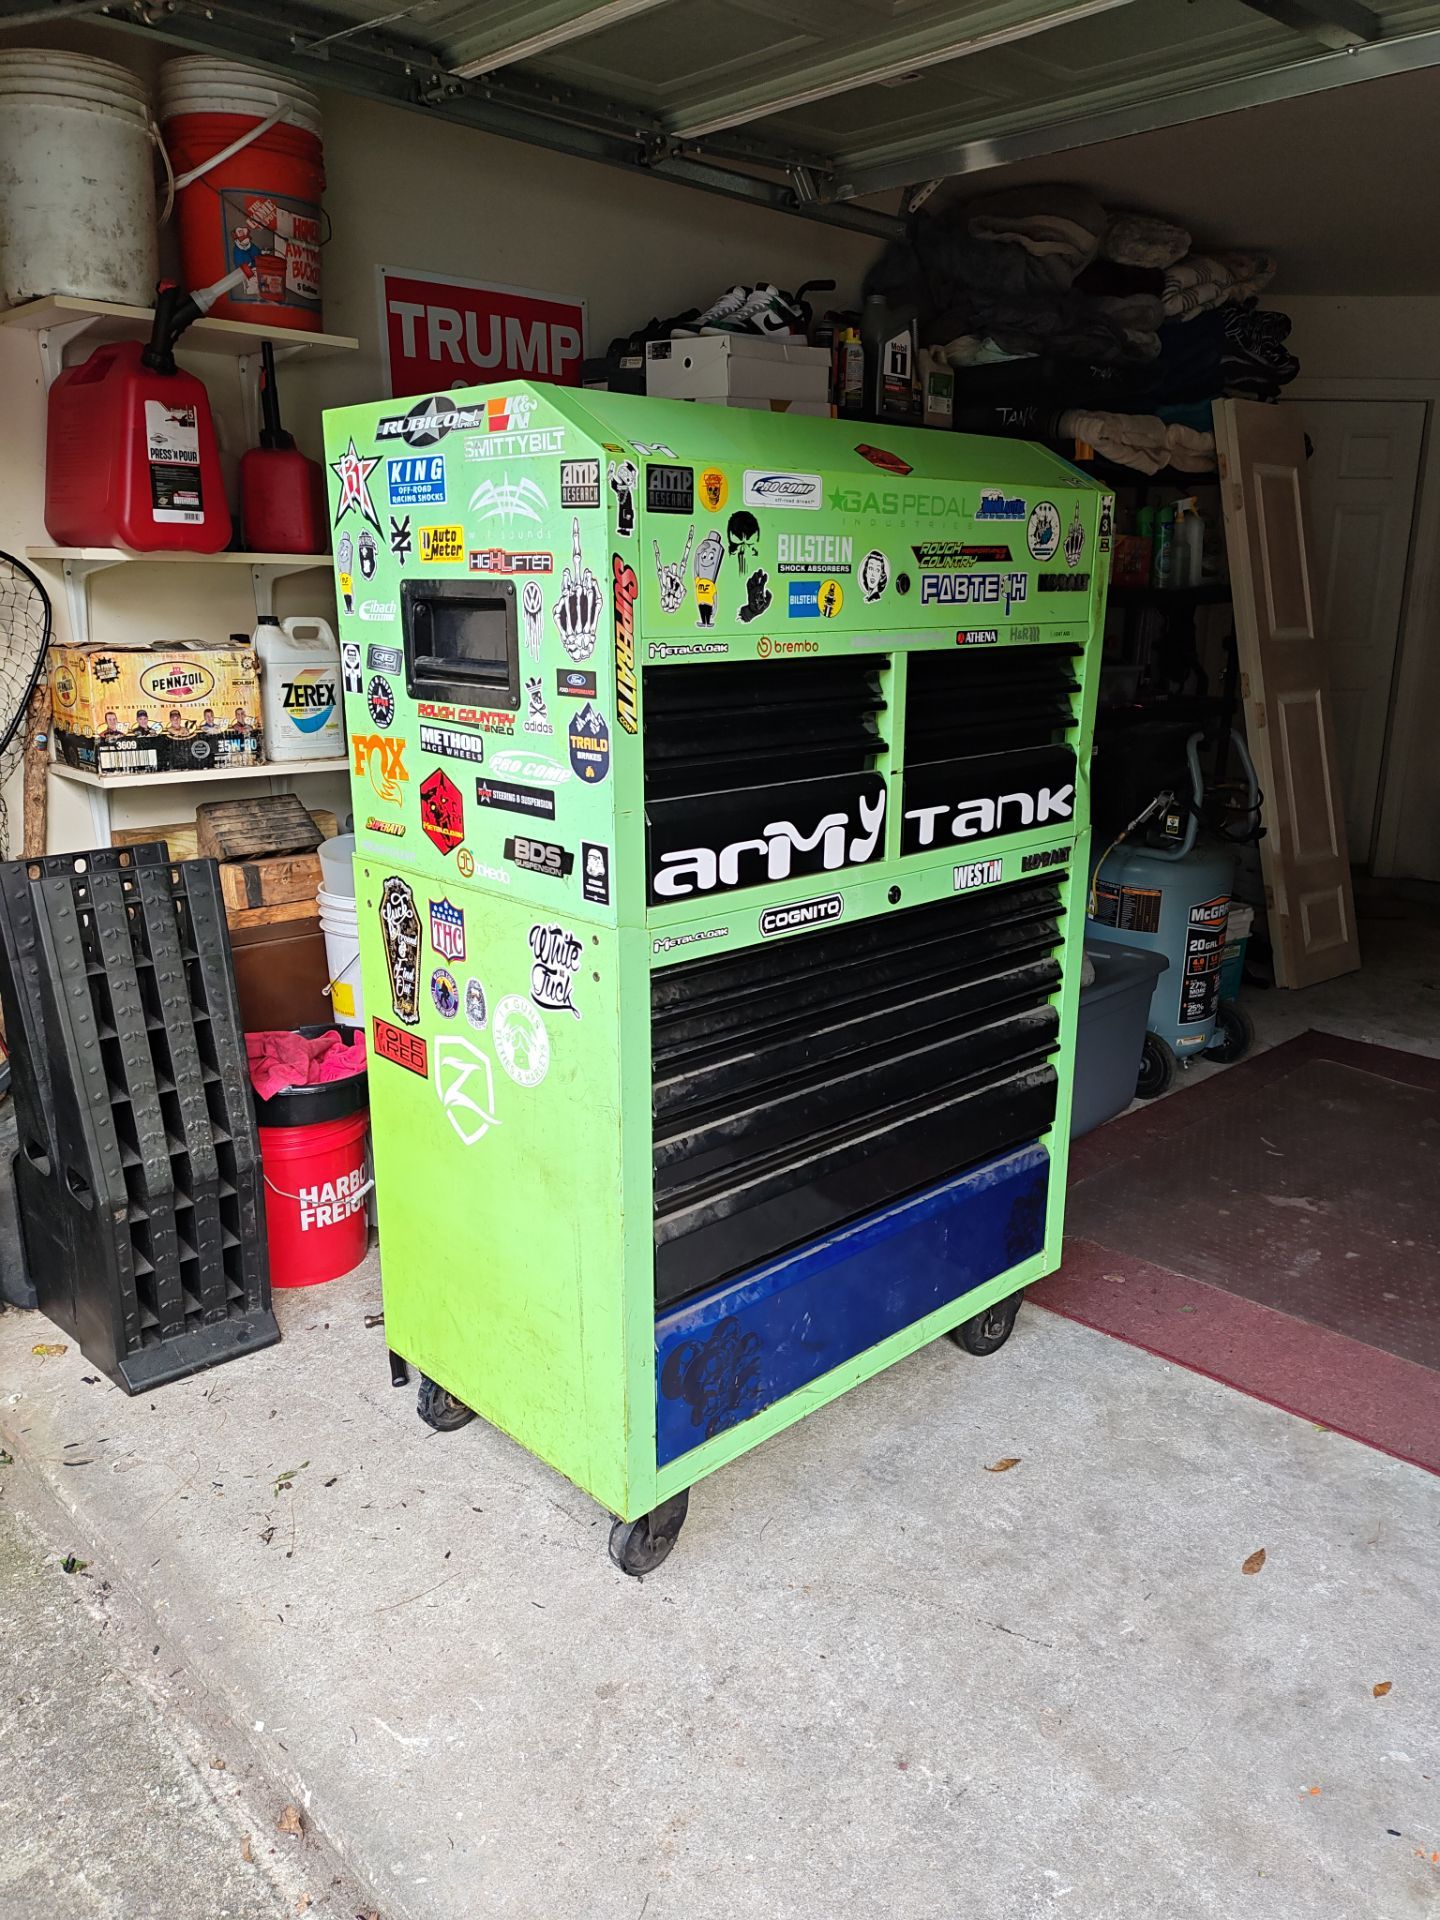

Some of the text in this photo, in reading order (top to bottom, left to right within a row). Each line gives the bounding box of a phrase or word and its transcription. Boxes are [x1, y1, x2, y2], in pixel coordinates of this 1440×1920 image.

[389, 300, 581, 376] TRUMP
[895, 354, 902, 373] 1
[381, 409, 478, 435] RUBICON
[453, 420, 480, 430] EXPRESS
[464, 431, 565, 457] SMITTYBILT
[179, 449, 198, 462] POUR
[391, 458, 443, 483] KING
[562, 463, 598, 485] AMP
[650, 469, 692, 491] AMP
[399, 485, 431, 494] OFF-ROAD
[562, 487, 598, 501] RESEARCH
[754, 481, 816, 494] PRO COMP
[392, 493, 443, 503] RACING SHOCKS
[649, 491, 692, 507] RESEARCH
[432, 529, 457, 542] Auto
[431, 543, 462, 557] Meter
[777, 534, 853, 563] BILSTEIN
[919, 542, 964, 555] ROUGH
[918, 556, 978, 569] COUNTRY
[922, 573, 1028, 604] FABTECH
[789, 594, 817, 605] BILSTEIN
[359, 600, 397, 621] Eibach
[774, 640, 819, 654] brembo
[964, 631, 997, 643] ATHENA
[151, 672, 204, 692] PENNZOIL
[281, 682, 337, 708] ZEREX
[418, 703, 515, 727] ROUGH COUNTRY
[524, 720, 553, 733] adidas
[116, 741, 137, 750] 3609
[420, 726, 482, 753] METHOD
[351, 734, 410, 780] FOX
[421, 742, 482, 761] RACE WHEELS
[489, 757, 572, 781] PRO COMP
[514, 837, 562, 868] BDS
[514, 858, 562, 877] SUSPENSION
[764, 900, 840, 930] COGNITO
[433, 920, 462, 956] THC
[1189, 938, 1205, 952] 20
[529, 925, 582, 972] White
[386, 1040, 424, 1069] RED
[299, 1162, 366, 1210] HARBO
